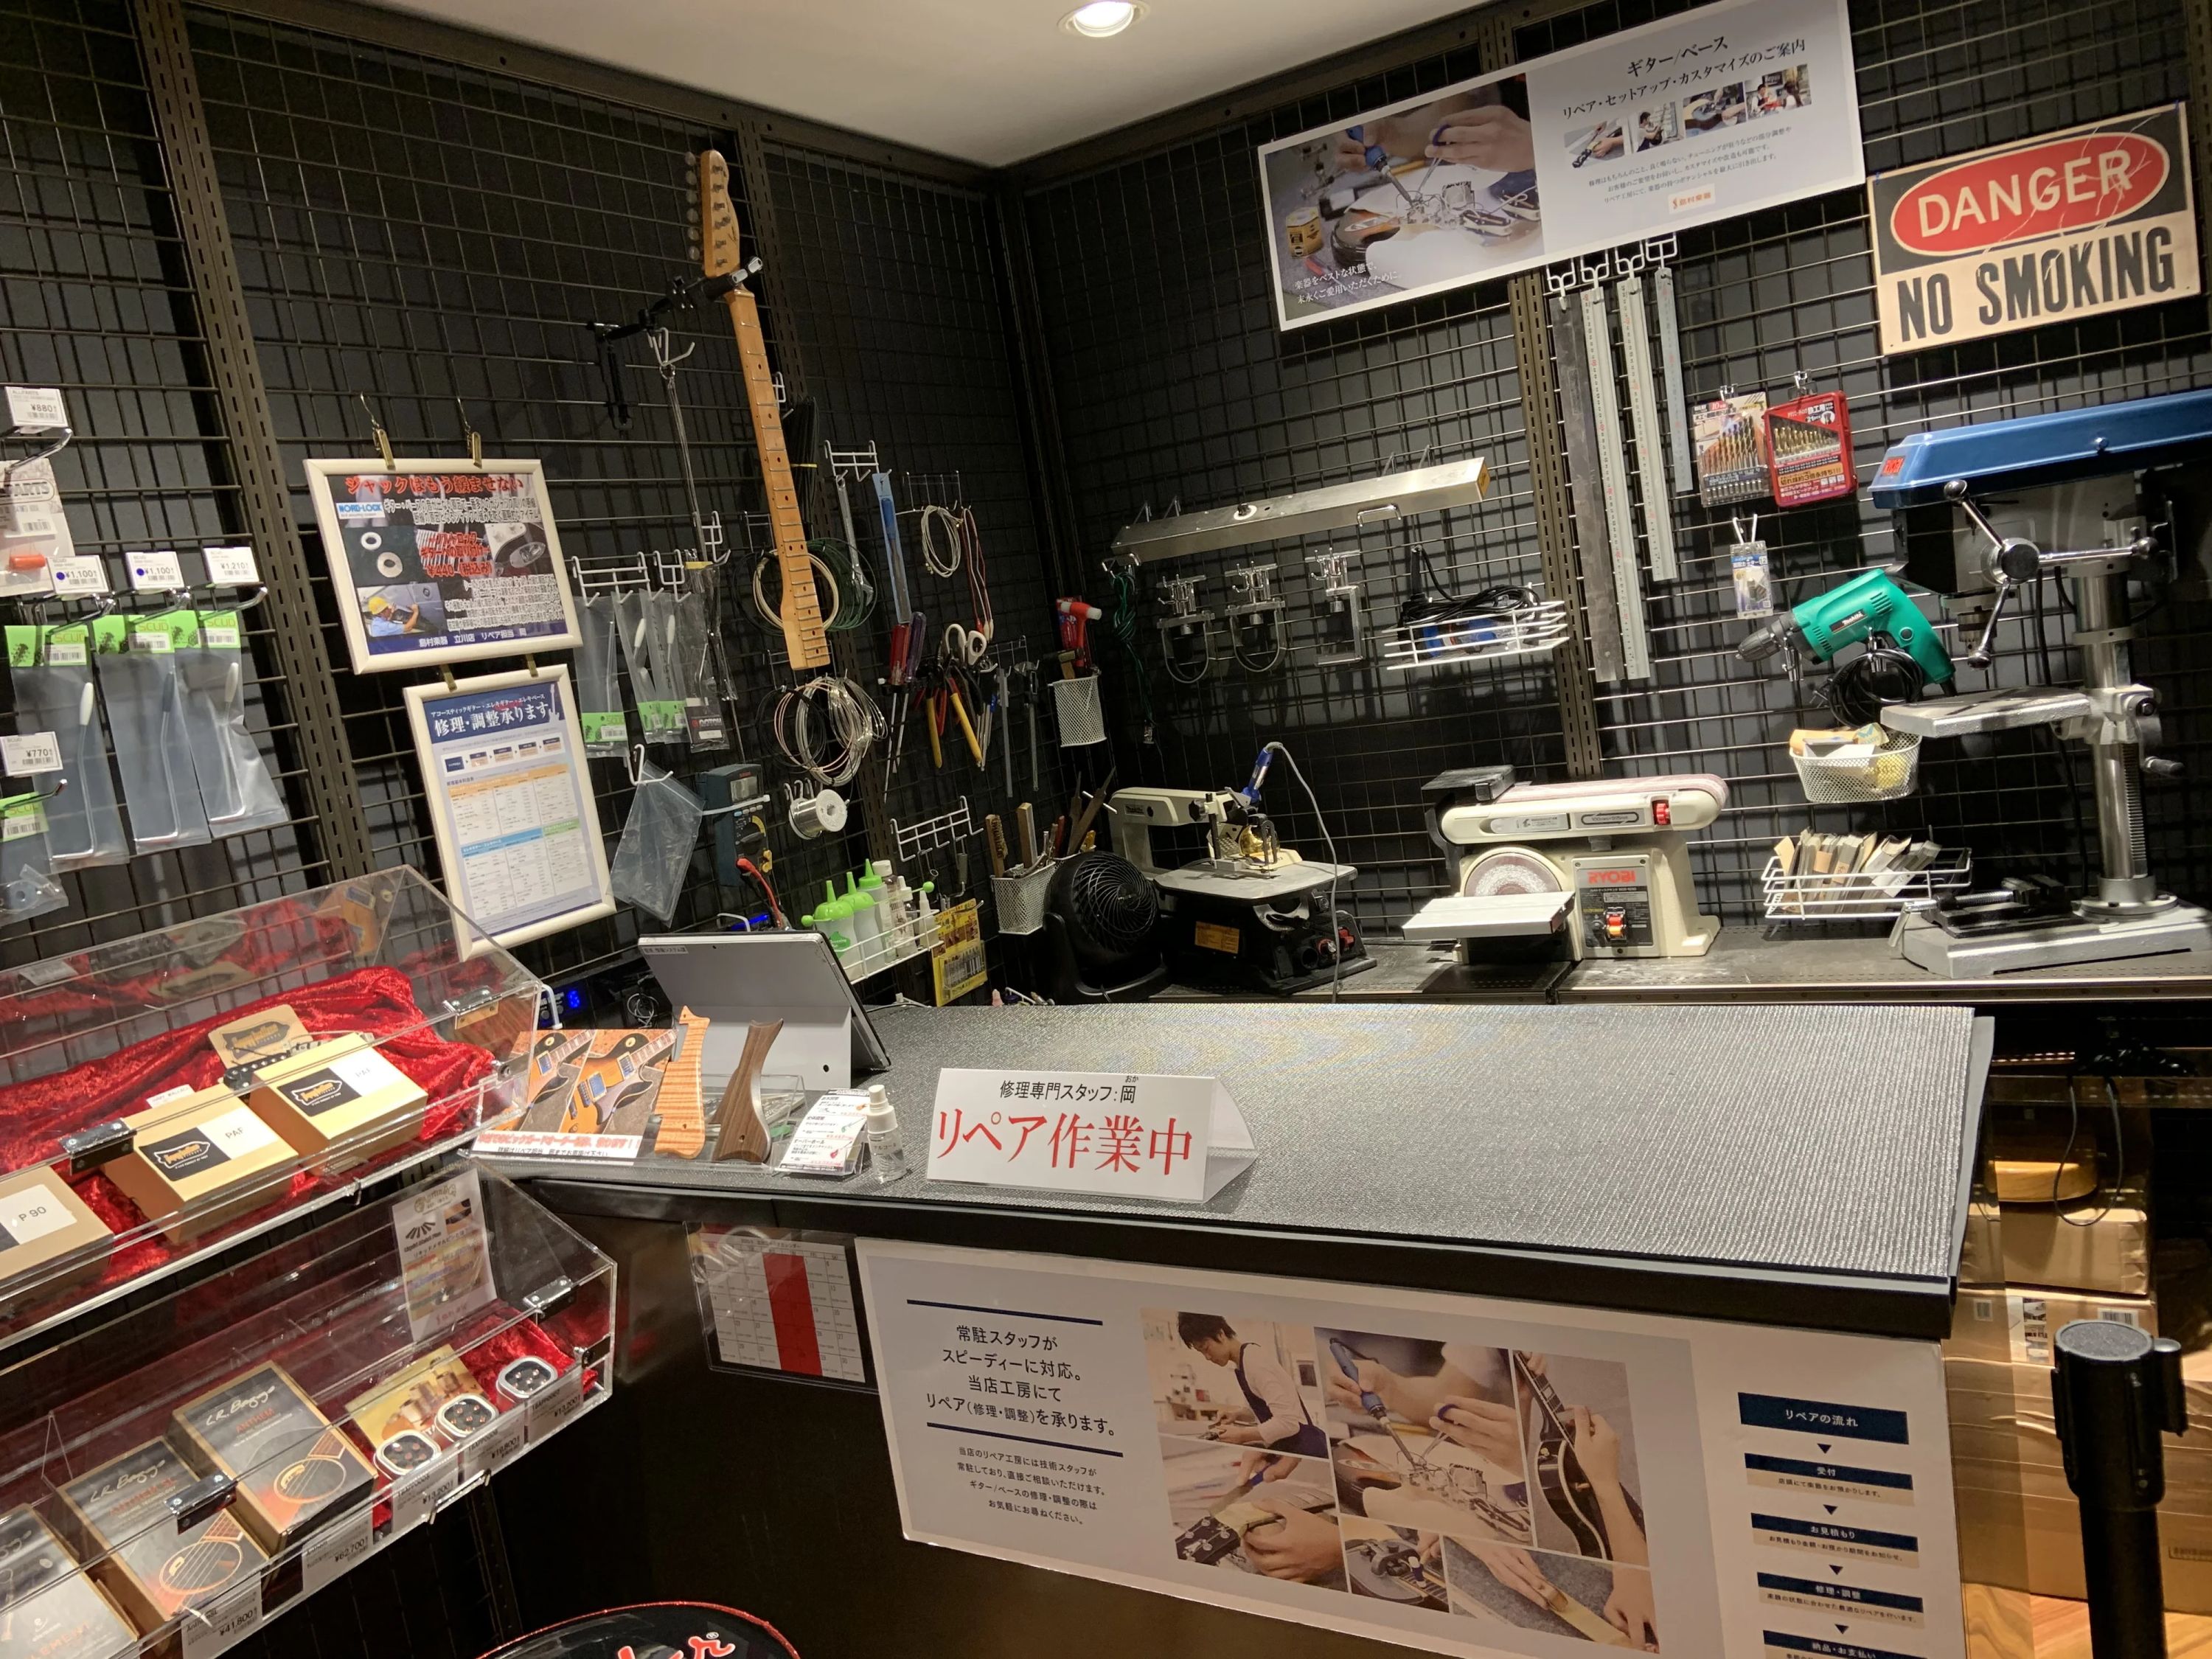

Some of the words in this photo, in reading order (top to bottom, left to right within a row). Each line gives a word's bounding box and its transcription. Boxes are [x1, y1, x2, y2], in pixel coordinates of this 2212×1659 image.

[1627, 36, 1728, 77] ギター/ベース
[1562, 39, 1806, 119] リペア・セットアップ・カスタマイズのご案内
[1918, 149, 2133, 238] DANGER
[1897, 273, 1954, 343] NO
[1976, 226, 2175, 326] SMOKING
[1587, 871, 1635, 884] RYOBI
[1124, 1075, 1138, 1083] おか
[936, 1108, 1193, 1176] リペア作業中
[956, 1325, 1058, 1351] 常駐スタッフが
[942, 1349, 1081, 1381] スピーディーに対応。
[968, 1376, 1062, 1402] 当店工房にて
[1785, 1409, 1859, 1427] リペアの流れ
[959, 1447, 1097, 1476] 当店のリペア工房には技術スタッフが
[1817, 1467, 1836, 1477] 受付
[1810, 1526, 1856, 1540] お見積もり
